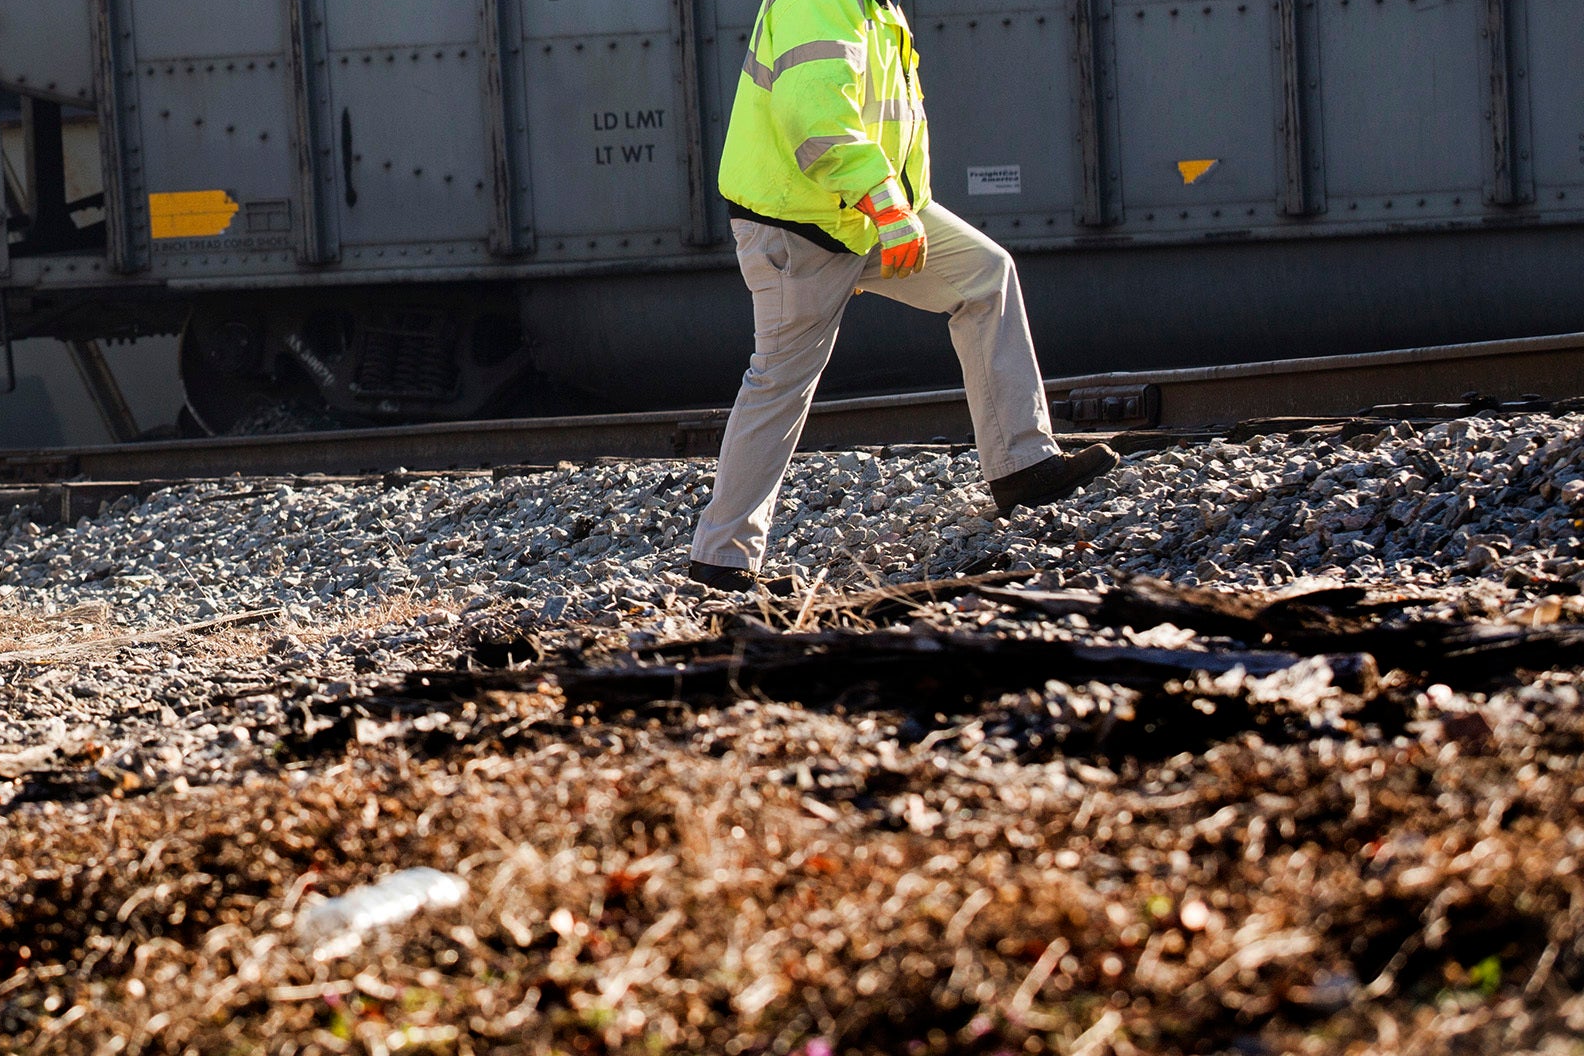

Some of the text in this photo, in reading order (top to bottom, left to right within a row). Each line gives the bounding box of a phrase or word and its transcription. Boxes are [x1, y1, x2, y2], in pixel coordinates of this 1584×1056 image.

[593, 109, 665, 131] LD LMT
[595, 144, 655, 165] LT WT
